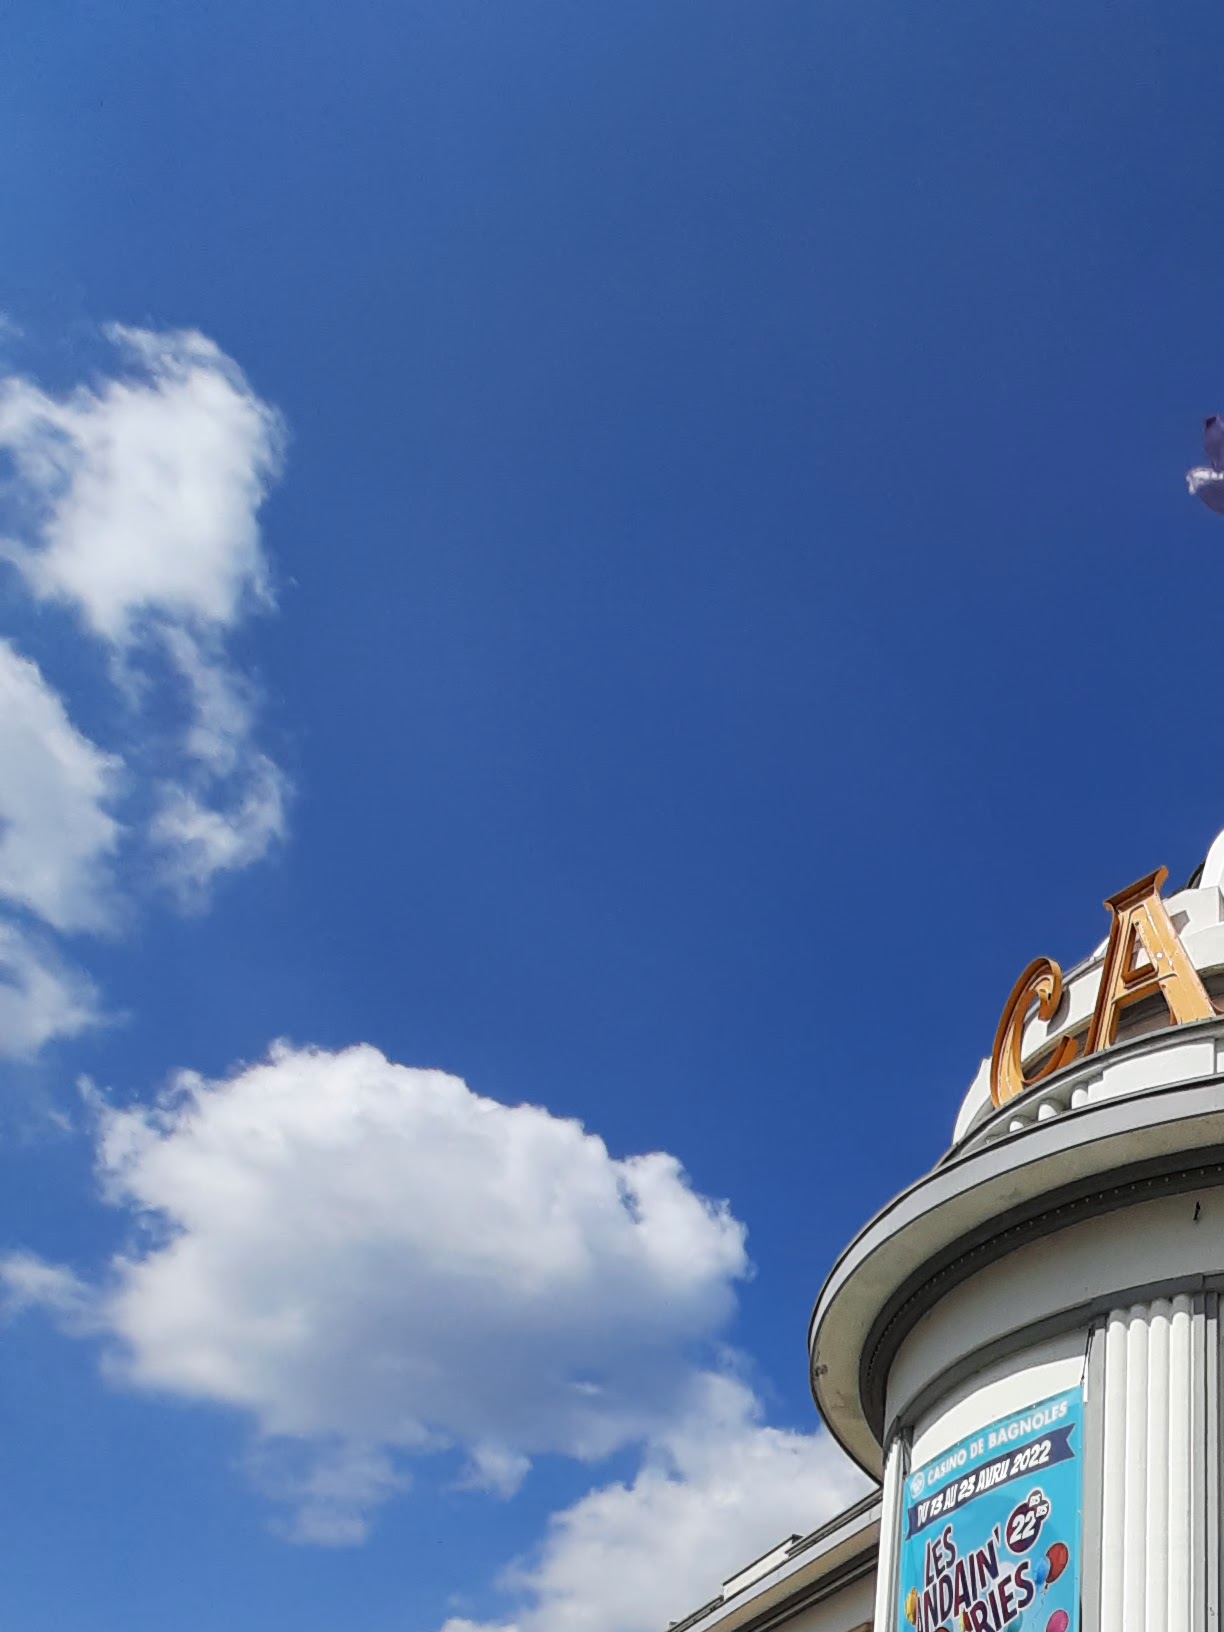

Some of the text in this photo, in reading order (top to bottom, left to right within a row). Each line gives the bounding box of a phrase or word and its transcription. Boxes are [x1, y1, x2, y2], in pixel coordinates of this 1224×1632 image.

[927, 1401, 1069, 1486] CASINO DE BAGNOLES
[917, 1503, 930, 1527] DU
[943, 1483, 959, 1510] AU
[957, 1475, 976, 1502] 23
[976, 1458, 1011, 1493] AVRIL
[1009, 1440, 1051, 1476] 2022
[924, 1525, 957, 1588] LES
[1009, 1511, 1036, 1544] 22
